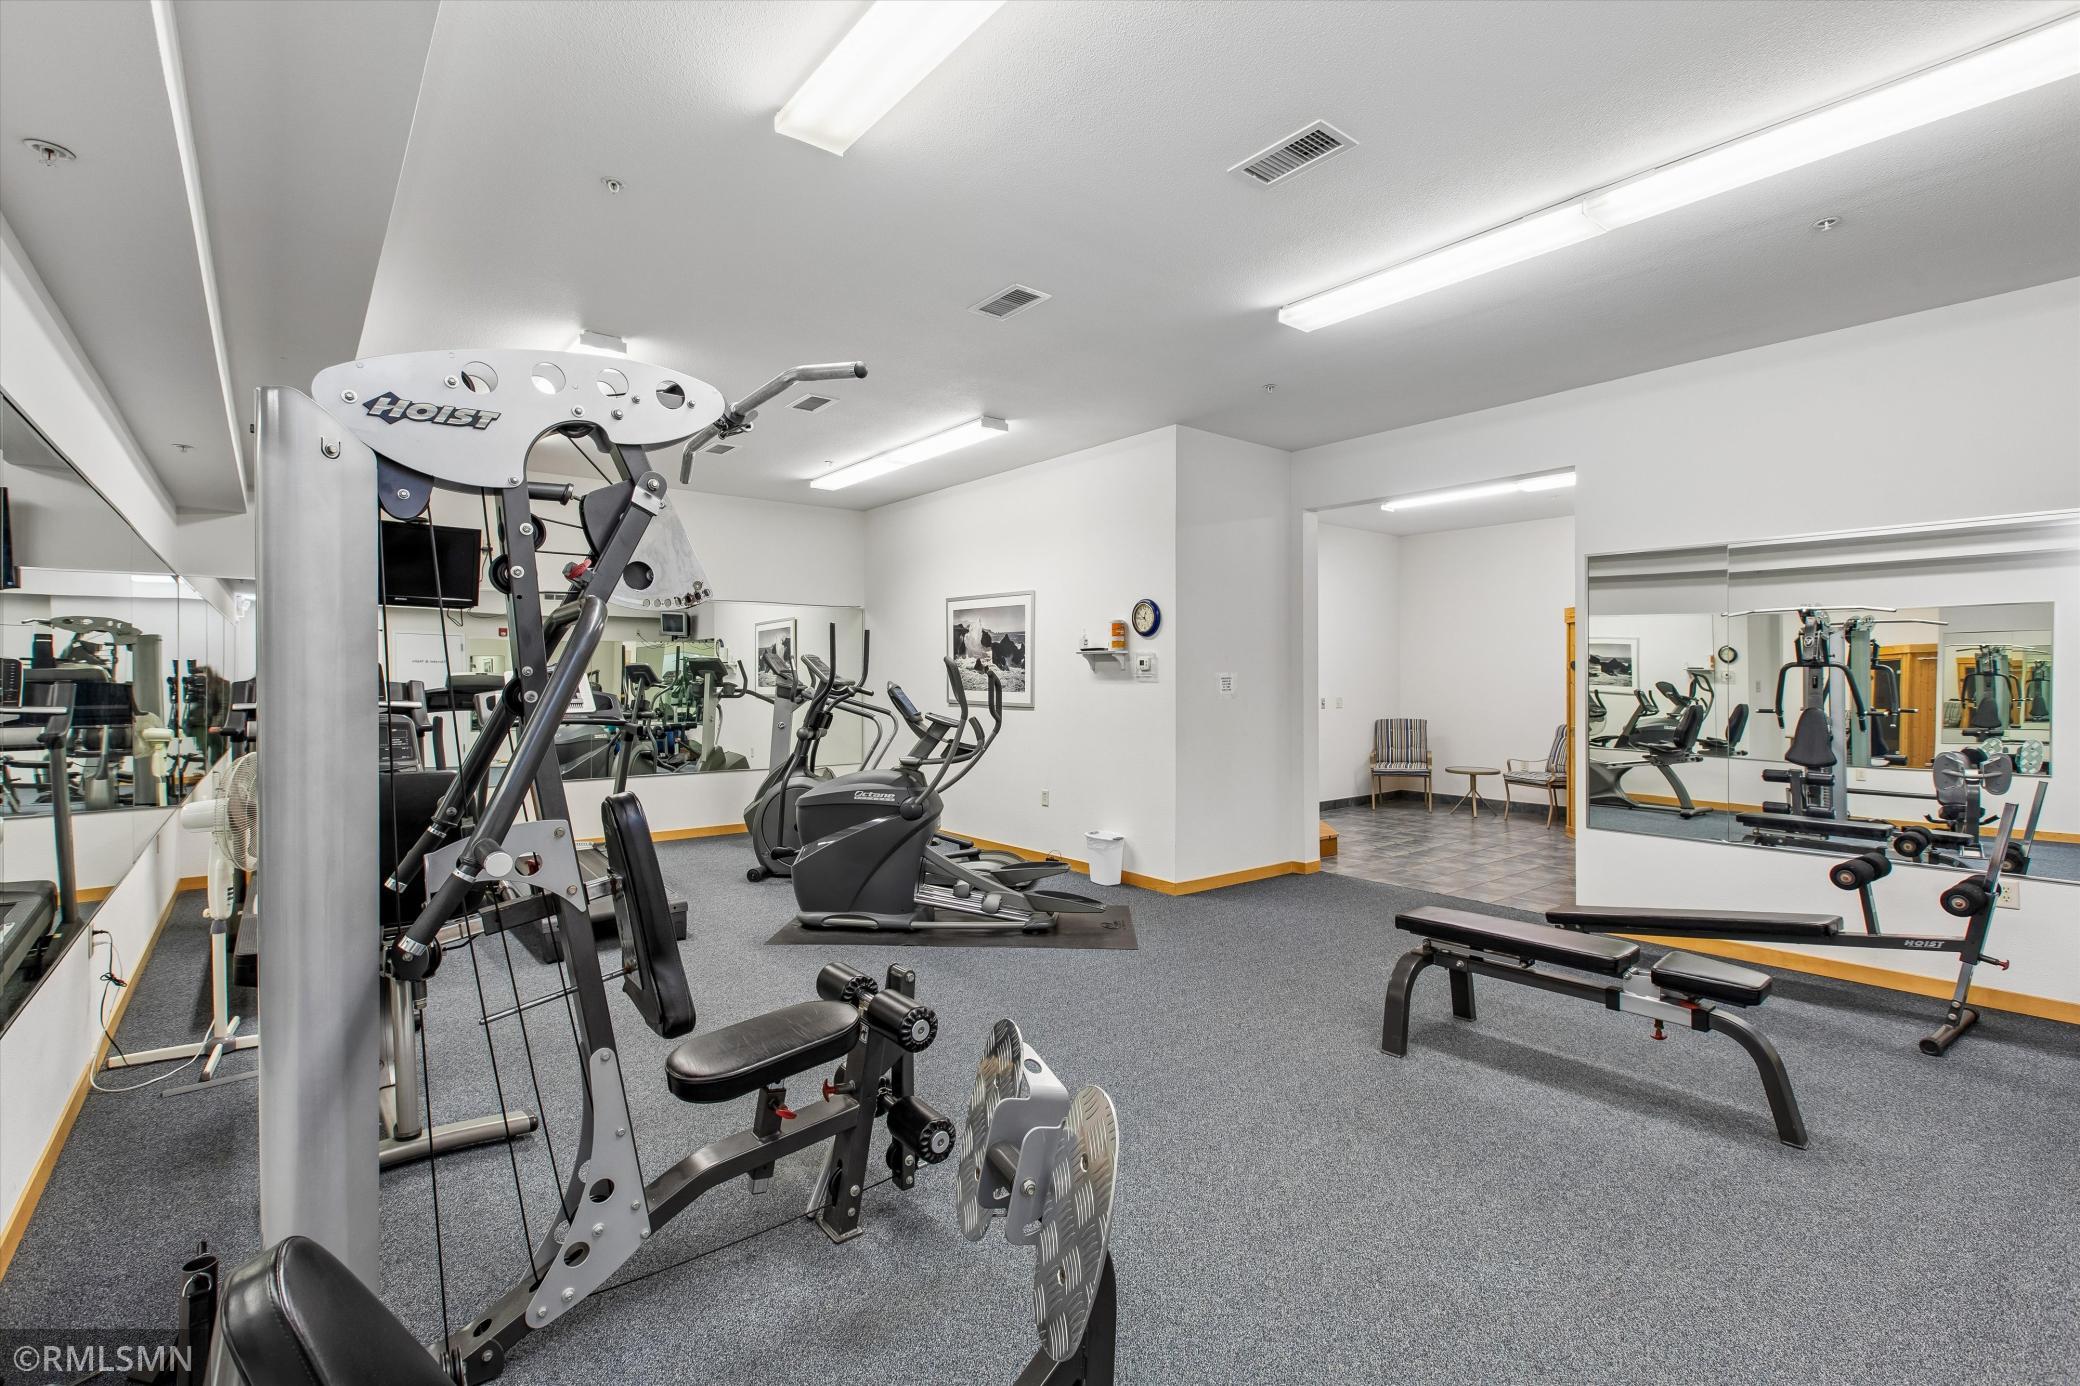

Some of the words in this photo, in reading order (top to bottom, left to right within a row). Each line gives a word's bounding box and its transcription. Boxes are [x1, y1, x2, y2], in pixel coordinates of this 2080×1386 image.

[367, 396, 501, 430] HOIST
[854, 790, 896, 798] Octane
[1903, 939, 1944, 949] HOIST
